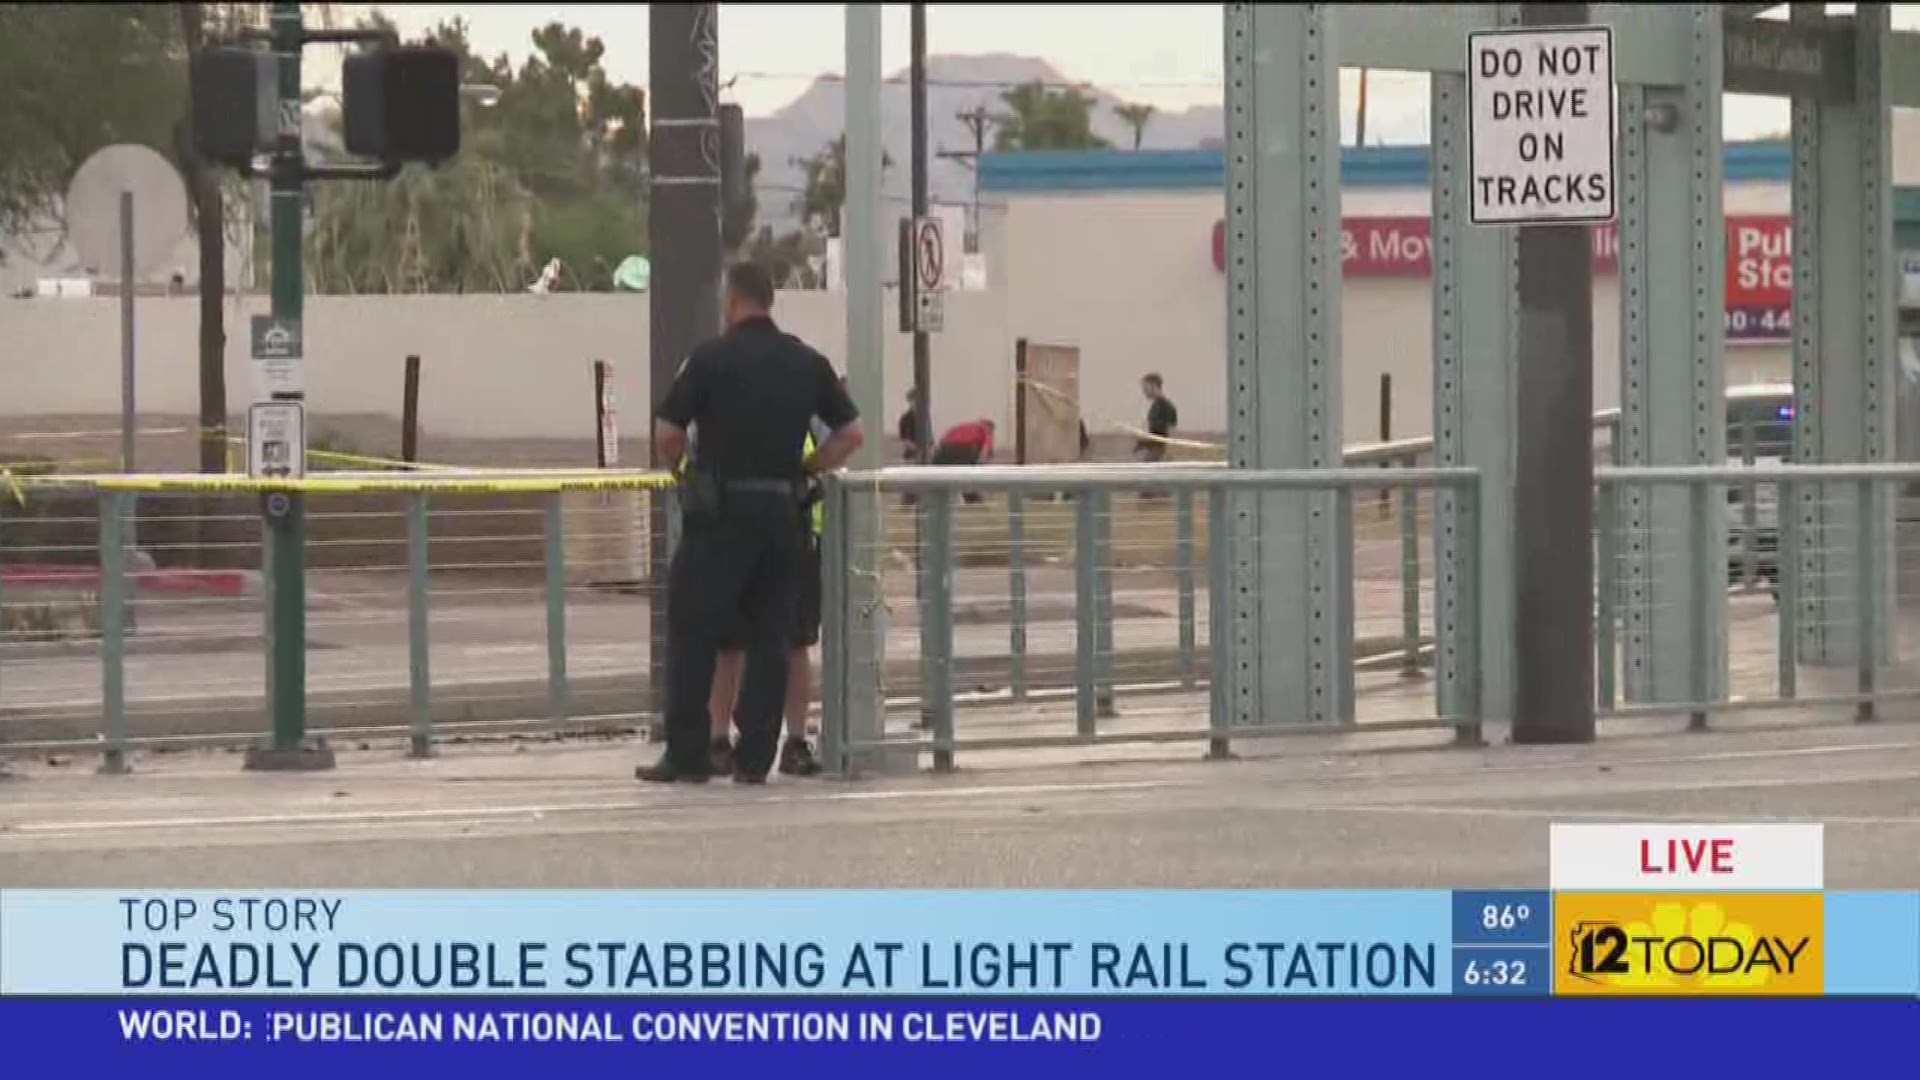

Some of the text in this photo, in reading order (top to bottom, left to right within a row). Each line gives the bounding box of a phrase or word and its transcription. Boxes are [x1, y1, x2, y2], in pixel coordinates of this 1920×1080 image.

[1481, 44, 1600, 78] DO NOT
[1493, 89, 1588, 120] DRIVE
[1519, 132, 1564, 162] ON
[1478, 173, 1606, 206] TRACKS
